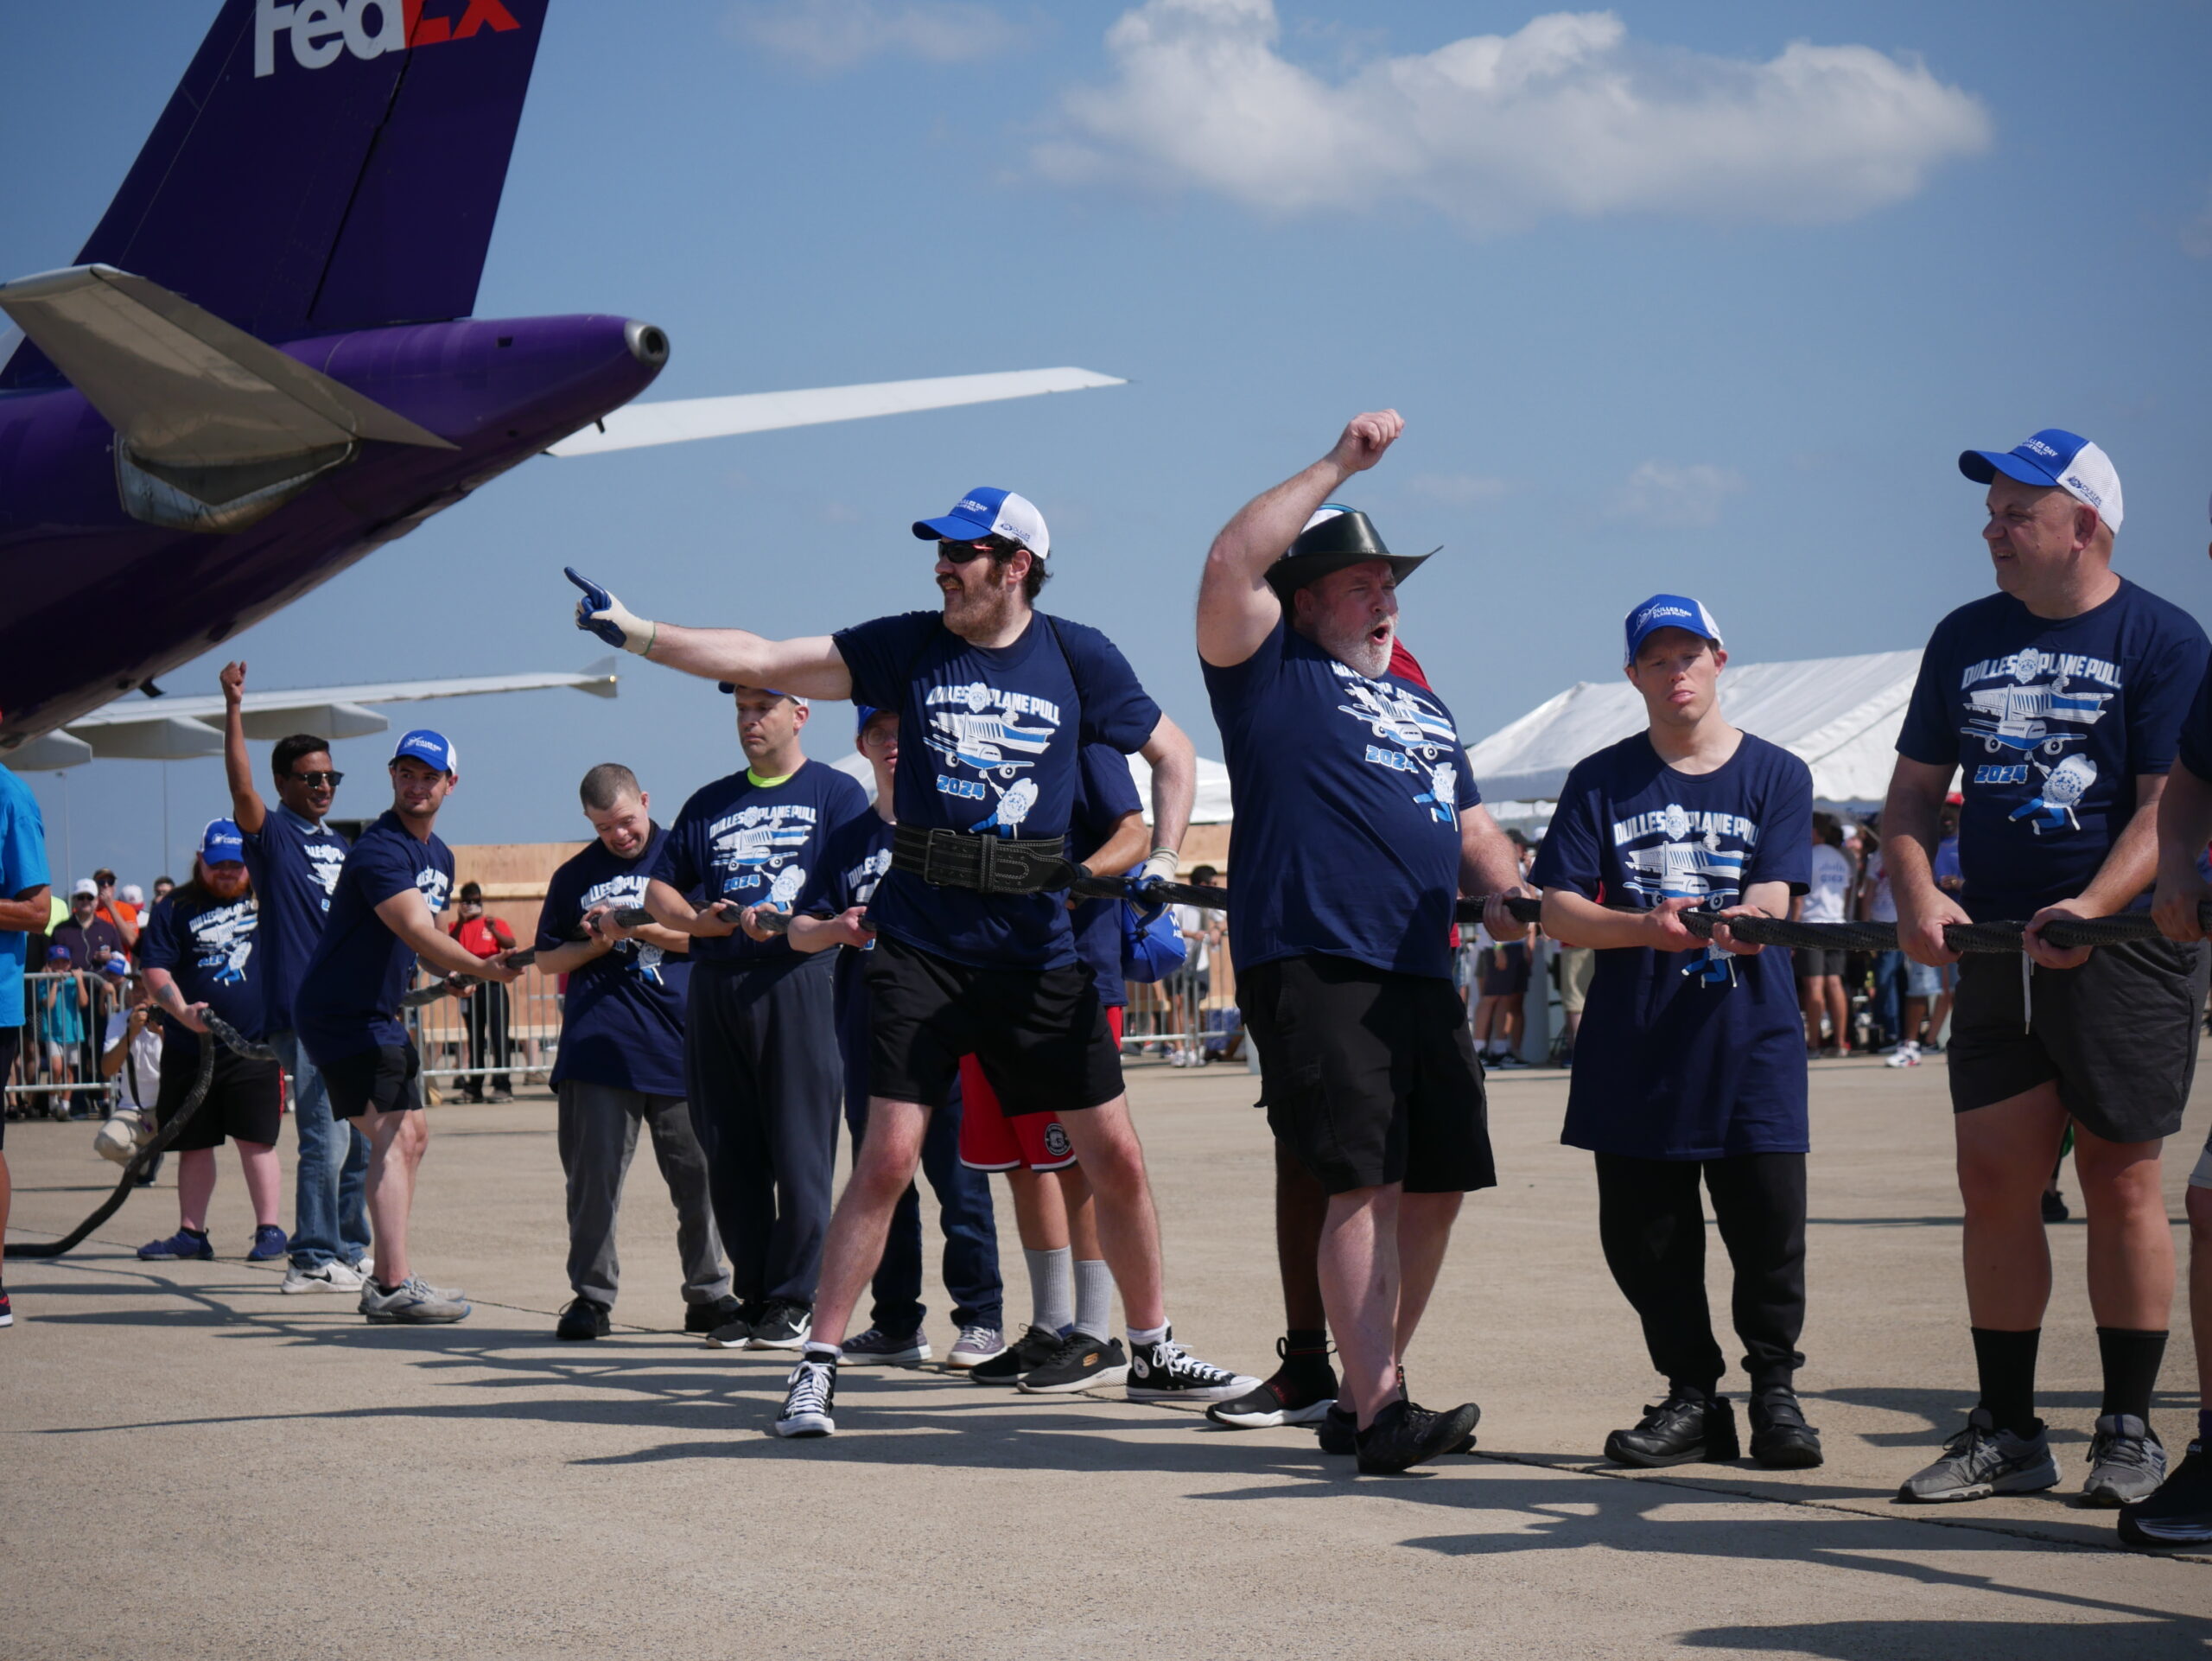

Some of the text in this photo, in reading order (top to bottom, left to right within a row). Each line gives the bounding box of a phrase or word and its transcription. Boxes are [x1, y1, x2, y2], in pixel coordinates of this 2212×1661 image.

[1652, 606, 1679, 615] DULLES
[1960, 654, 2019, 691] DULLES
[2036, 652, 2087, 677] PLANE
[2083, 658, 2123, 690] PULL
[987, 688, 1030, 714] PLANE
[1028, 696, 1061, 727] PULL
[1363, 743, 1420, 775] 2024
[936, 773, 987, 801] 2024
[1974, 764, 2029, 785] 2024
[709, 804, 817, 840] DULLES PLANE PULL
[1613, 810, 1667, 847] DULLES
[1684, 810, 1732, 836] PLANE
[622, 875, 651, 890] PLAN
[723, 874, 761, 894] 2024
[848, 856, 879, 889] DULES
[189, 909, 217, 933] DULLES
